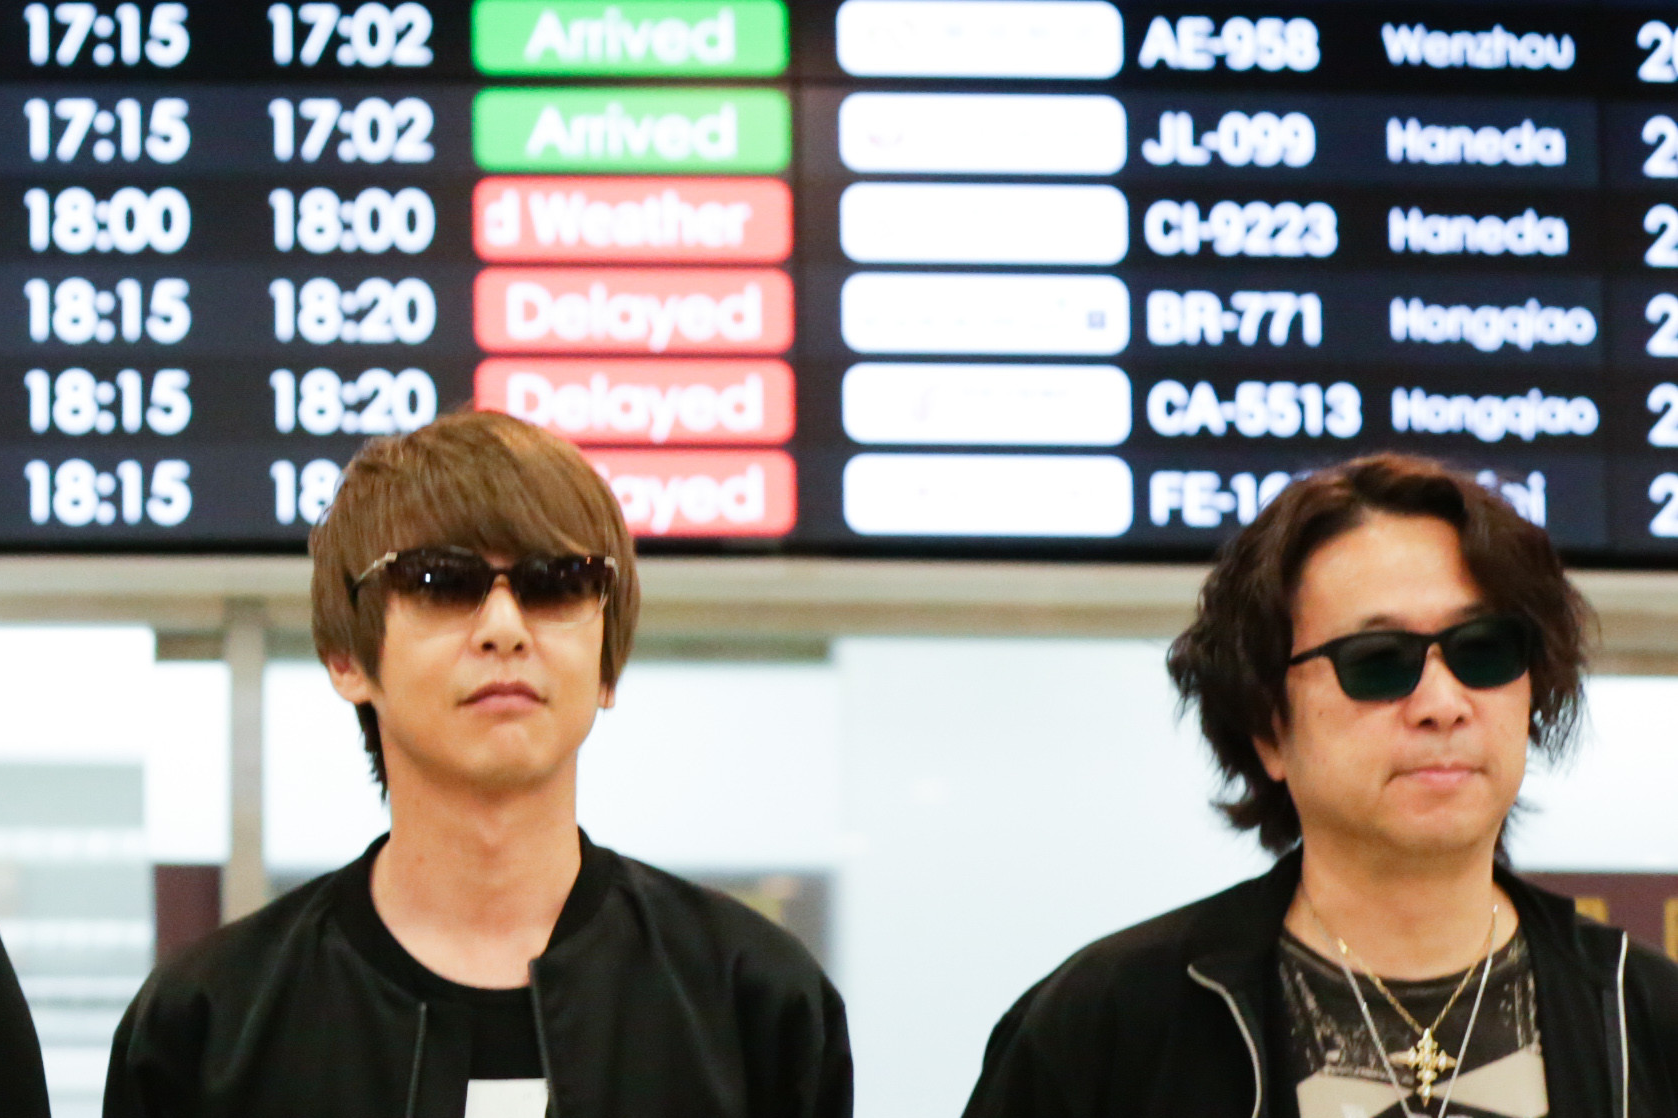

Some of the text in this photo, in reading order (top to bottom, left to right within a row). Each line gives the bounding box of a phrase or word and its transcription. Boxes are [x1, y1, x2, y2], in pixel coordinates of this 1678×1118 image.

[26, 4, 189, 66] 17:15
[270, 3, 431, 66] 17:02
[526, 9, 735, 63] Arrived
[1140, 18, 1574, 70] AE-958 Wenzhou
[25, 99, 190, 162] 17:15
[269, 98, 433, 162] 17:02
[527, 102, 738, 160] Arrived
[1143, 112, 1565, 166] JL-099 Haneda
[25, 188, 190, 252] 18:00
[269, 188, 434, 253] 18:00
[528, 189, 753, 248] Weather
[1145, 201, 1567, 256] CI-9223 Haneda
[25, 278, 190, 343] 18:15
[270, 278, 435, 343] 18:20
[505, 281, 763, 351] Delayed
[1147, 291, 1321, 346] BR-771
[1391, 299, 1596, 350] Hongqiao
[25, 369, 191, 434] 18:15
[271, 369, 436, 434] 18:20
[506, 372, 765, 442] Delayed
[1148, 381, 1361, 437] CA-5513
[1392, 389, 1598, 441] Hongqiao
[25, 459, 191, 525] 18:15
[594, 463, 766, 533] ayed
